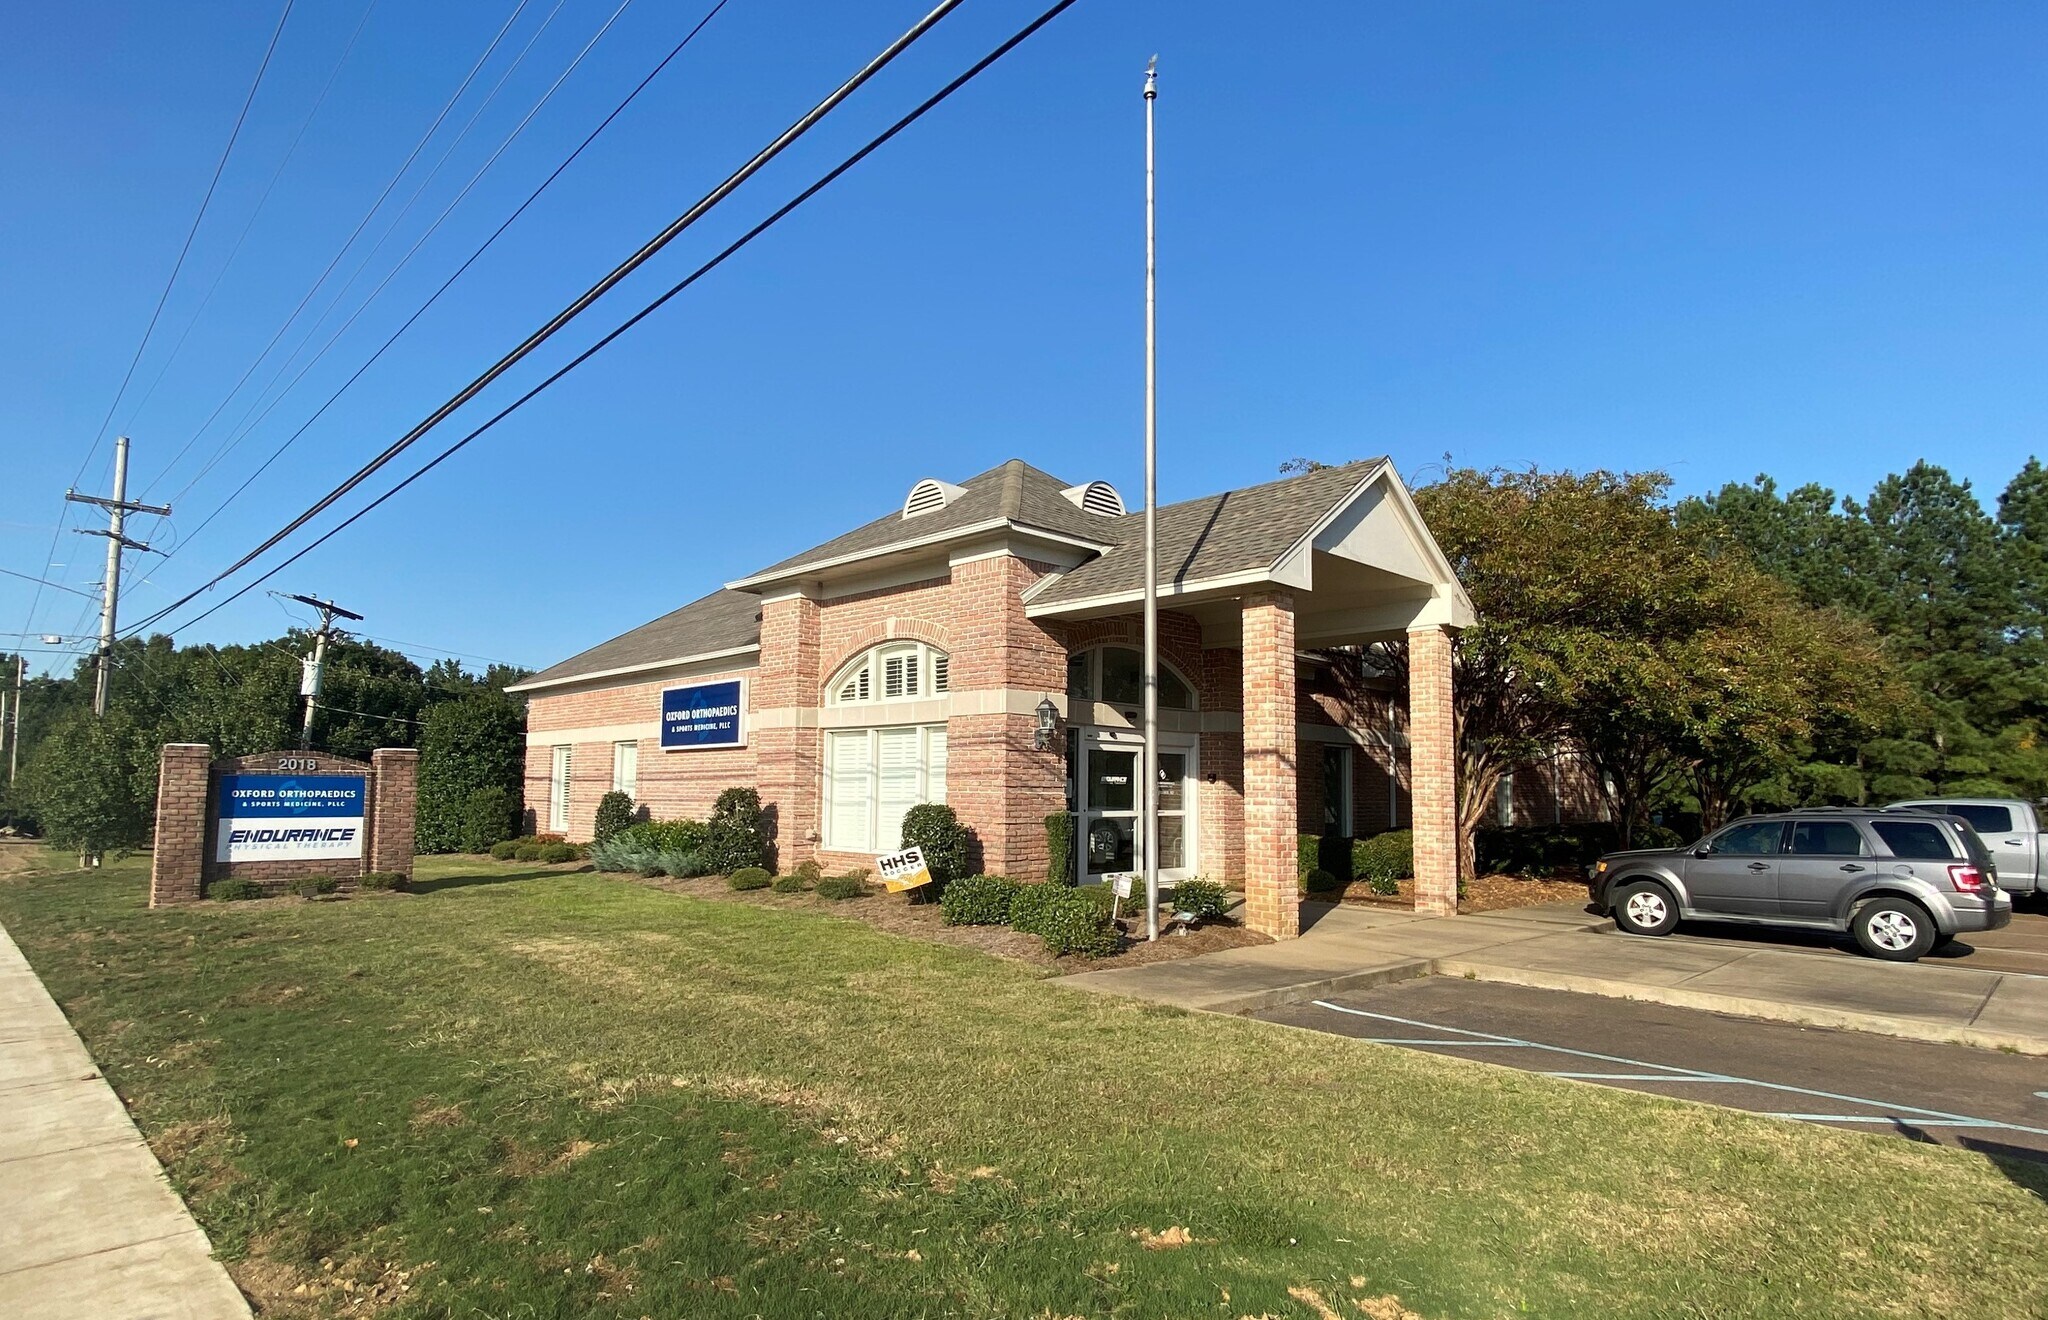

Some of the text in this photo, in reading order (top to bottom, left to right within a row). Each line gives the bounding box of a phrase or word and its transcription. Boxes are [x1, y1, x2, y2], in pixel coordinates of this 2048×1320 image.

[666, 705, 737, 721] OXFORD ORTHOPAEDICS
[279, 758, 316, 771] 2018
[231, 789, 356, 798] OXFORD ORTHOPAEDICS
[228, 828, 356, 843] ENDURANCE
[225, 841, 352, 851] PHYSICAL THERAPY
[880, 851, 920, 871] HHS
[883, 862, 922, 876] SOCCER
